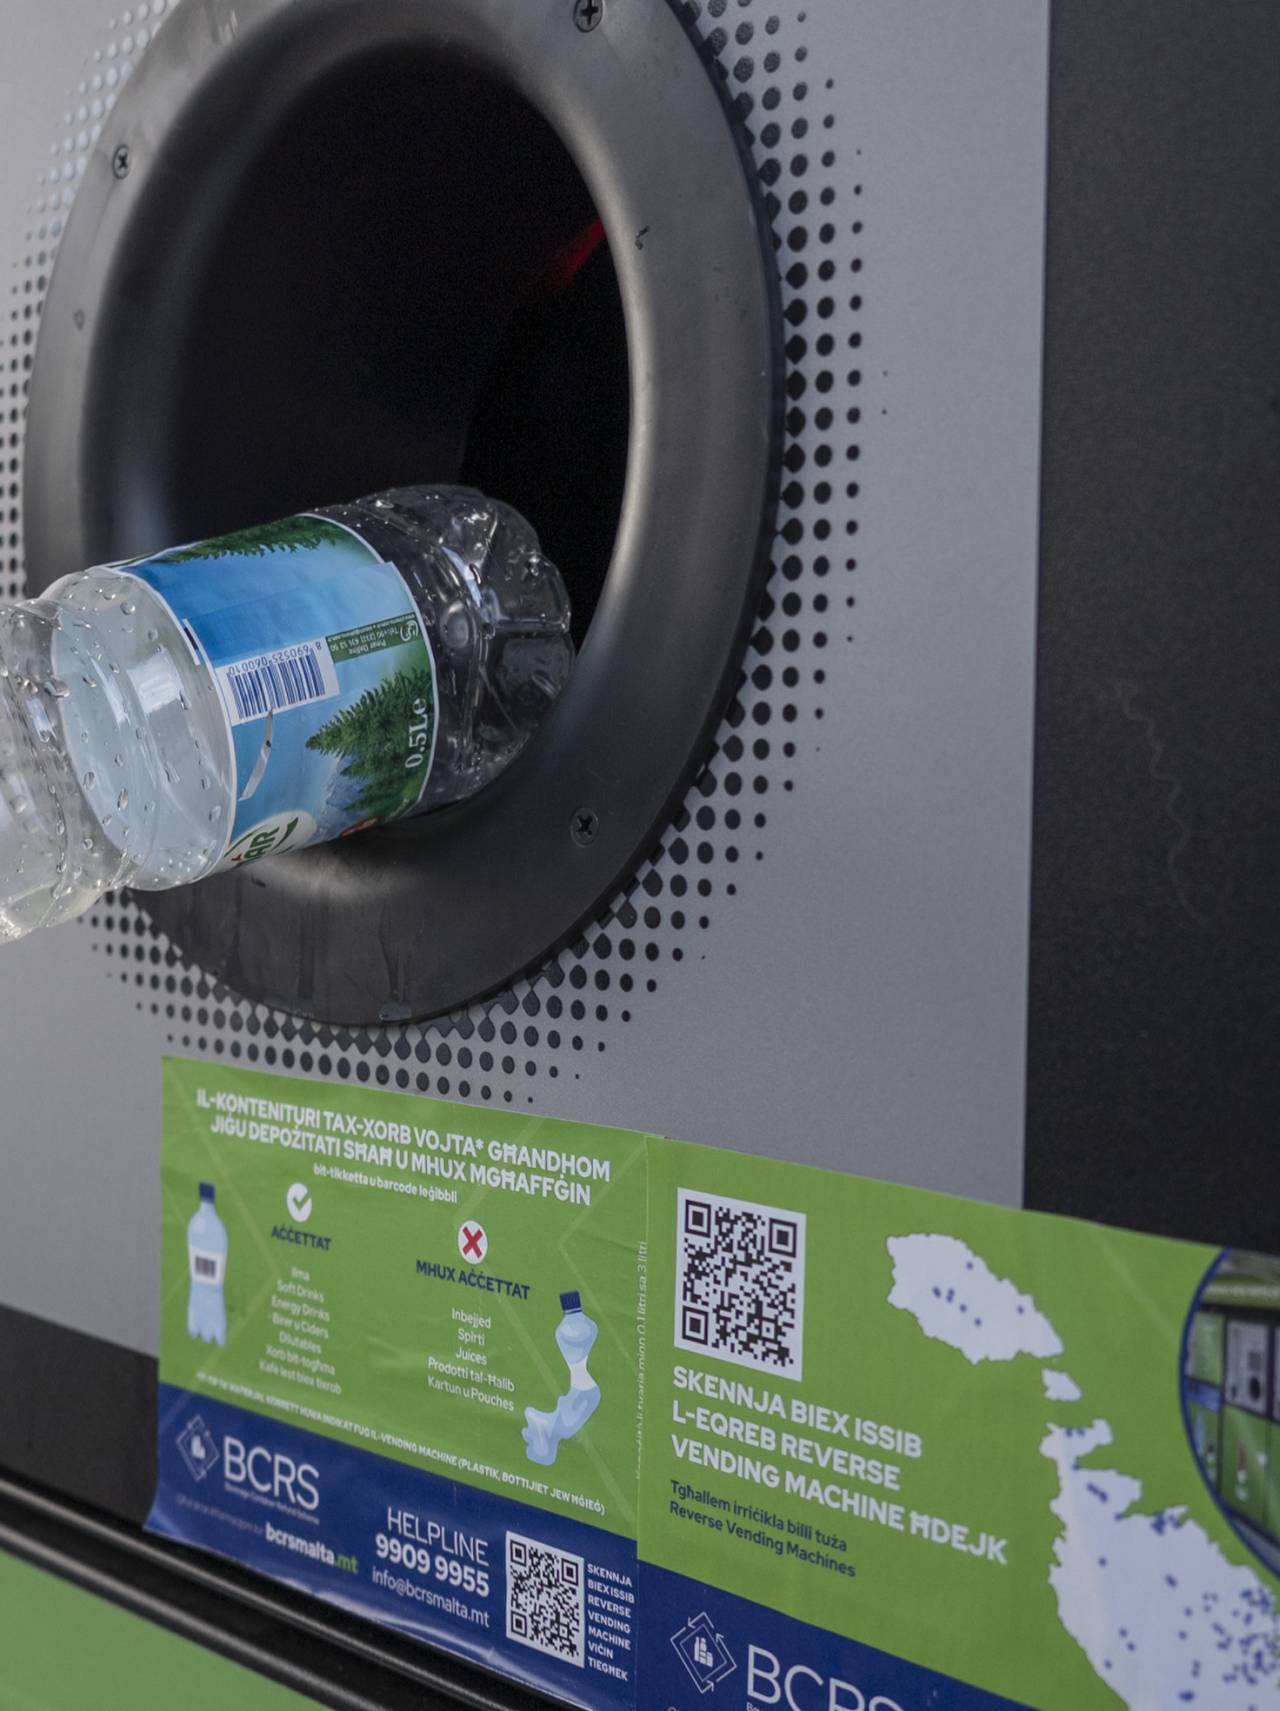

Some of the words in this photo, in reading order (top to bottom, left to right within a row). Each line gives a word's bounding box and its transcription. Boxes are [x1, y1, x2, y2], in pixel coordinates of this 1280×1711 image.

[196, 1089, 320, 1130] IL-KONTENITURI
[323, 1111, 411, 1146] TAX-XORB
[395, 1148, 408, 1169] U
[410, 1151, 466, 1182] MHUX
[376, 1175, 418, 1197] barcode
[416, 1259, 456, 1282] MHUX
[457, 1328, 485, 1346] Spirti
[428, 1357, 469, 1380] Prodotti
[455, 1346, 488, 1366] Juices
[427, 1376, 462, 1395] Kartun
[462, 1387, 470, 1399] u
[471, 1387, 515, 1411] Pouches
[672, 1365, 787, 1420] SKENNJA
[790, 1399, 849, 1438] BIEX
[855, 1418, 923, 1458] ISSIB
[672, 1400, 777, 1451] L-EQREB
[781, 1433, 901, 1491] REVERSE
[224, 1436, 320, 1510] BCRS
[419, 1443, 457, 1467] MACHINE
[550, 1487, 570, 1502] JEW
[671, 1433, 780, 1489] VENDING
[784, 1470, 905, 1531] MACHINE
[387, 1506, 489, 1567] HELPLINE
[670, 1501, 724, 1532] Reverse
[725, 1519, 784, 1556] Vending
[786, 1542, 857, 1578] Machines
[786, 1516, 812, 1541] billi
[265, 1521, 358, 1575] bcrsmalta.mt
[375, 1533, 431, 1580] 9909
[434, 1559, 489, 1598] 9955
[587, 1563, 632, 1588] SKENNJA
[587, 1578, 610, 1595] BIEX
[610, 1587, 635, 1604] ISSIB
[371, 1565, 490, 1629] info@bcrsmalta.mt
[587, 1594, 631, 1619] REVERSE
[587, 1609, 631, 1634] VENDING
[588, 1625, 631, 1651] MACHINE
[747, 1644, 904, 1711] BCR
